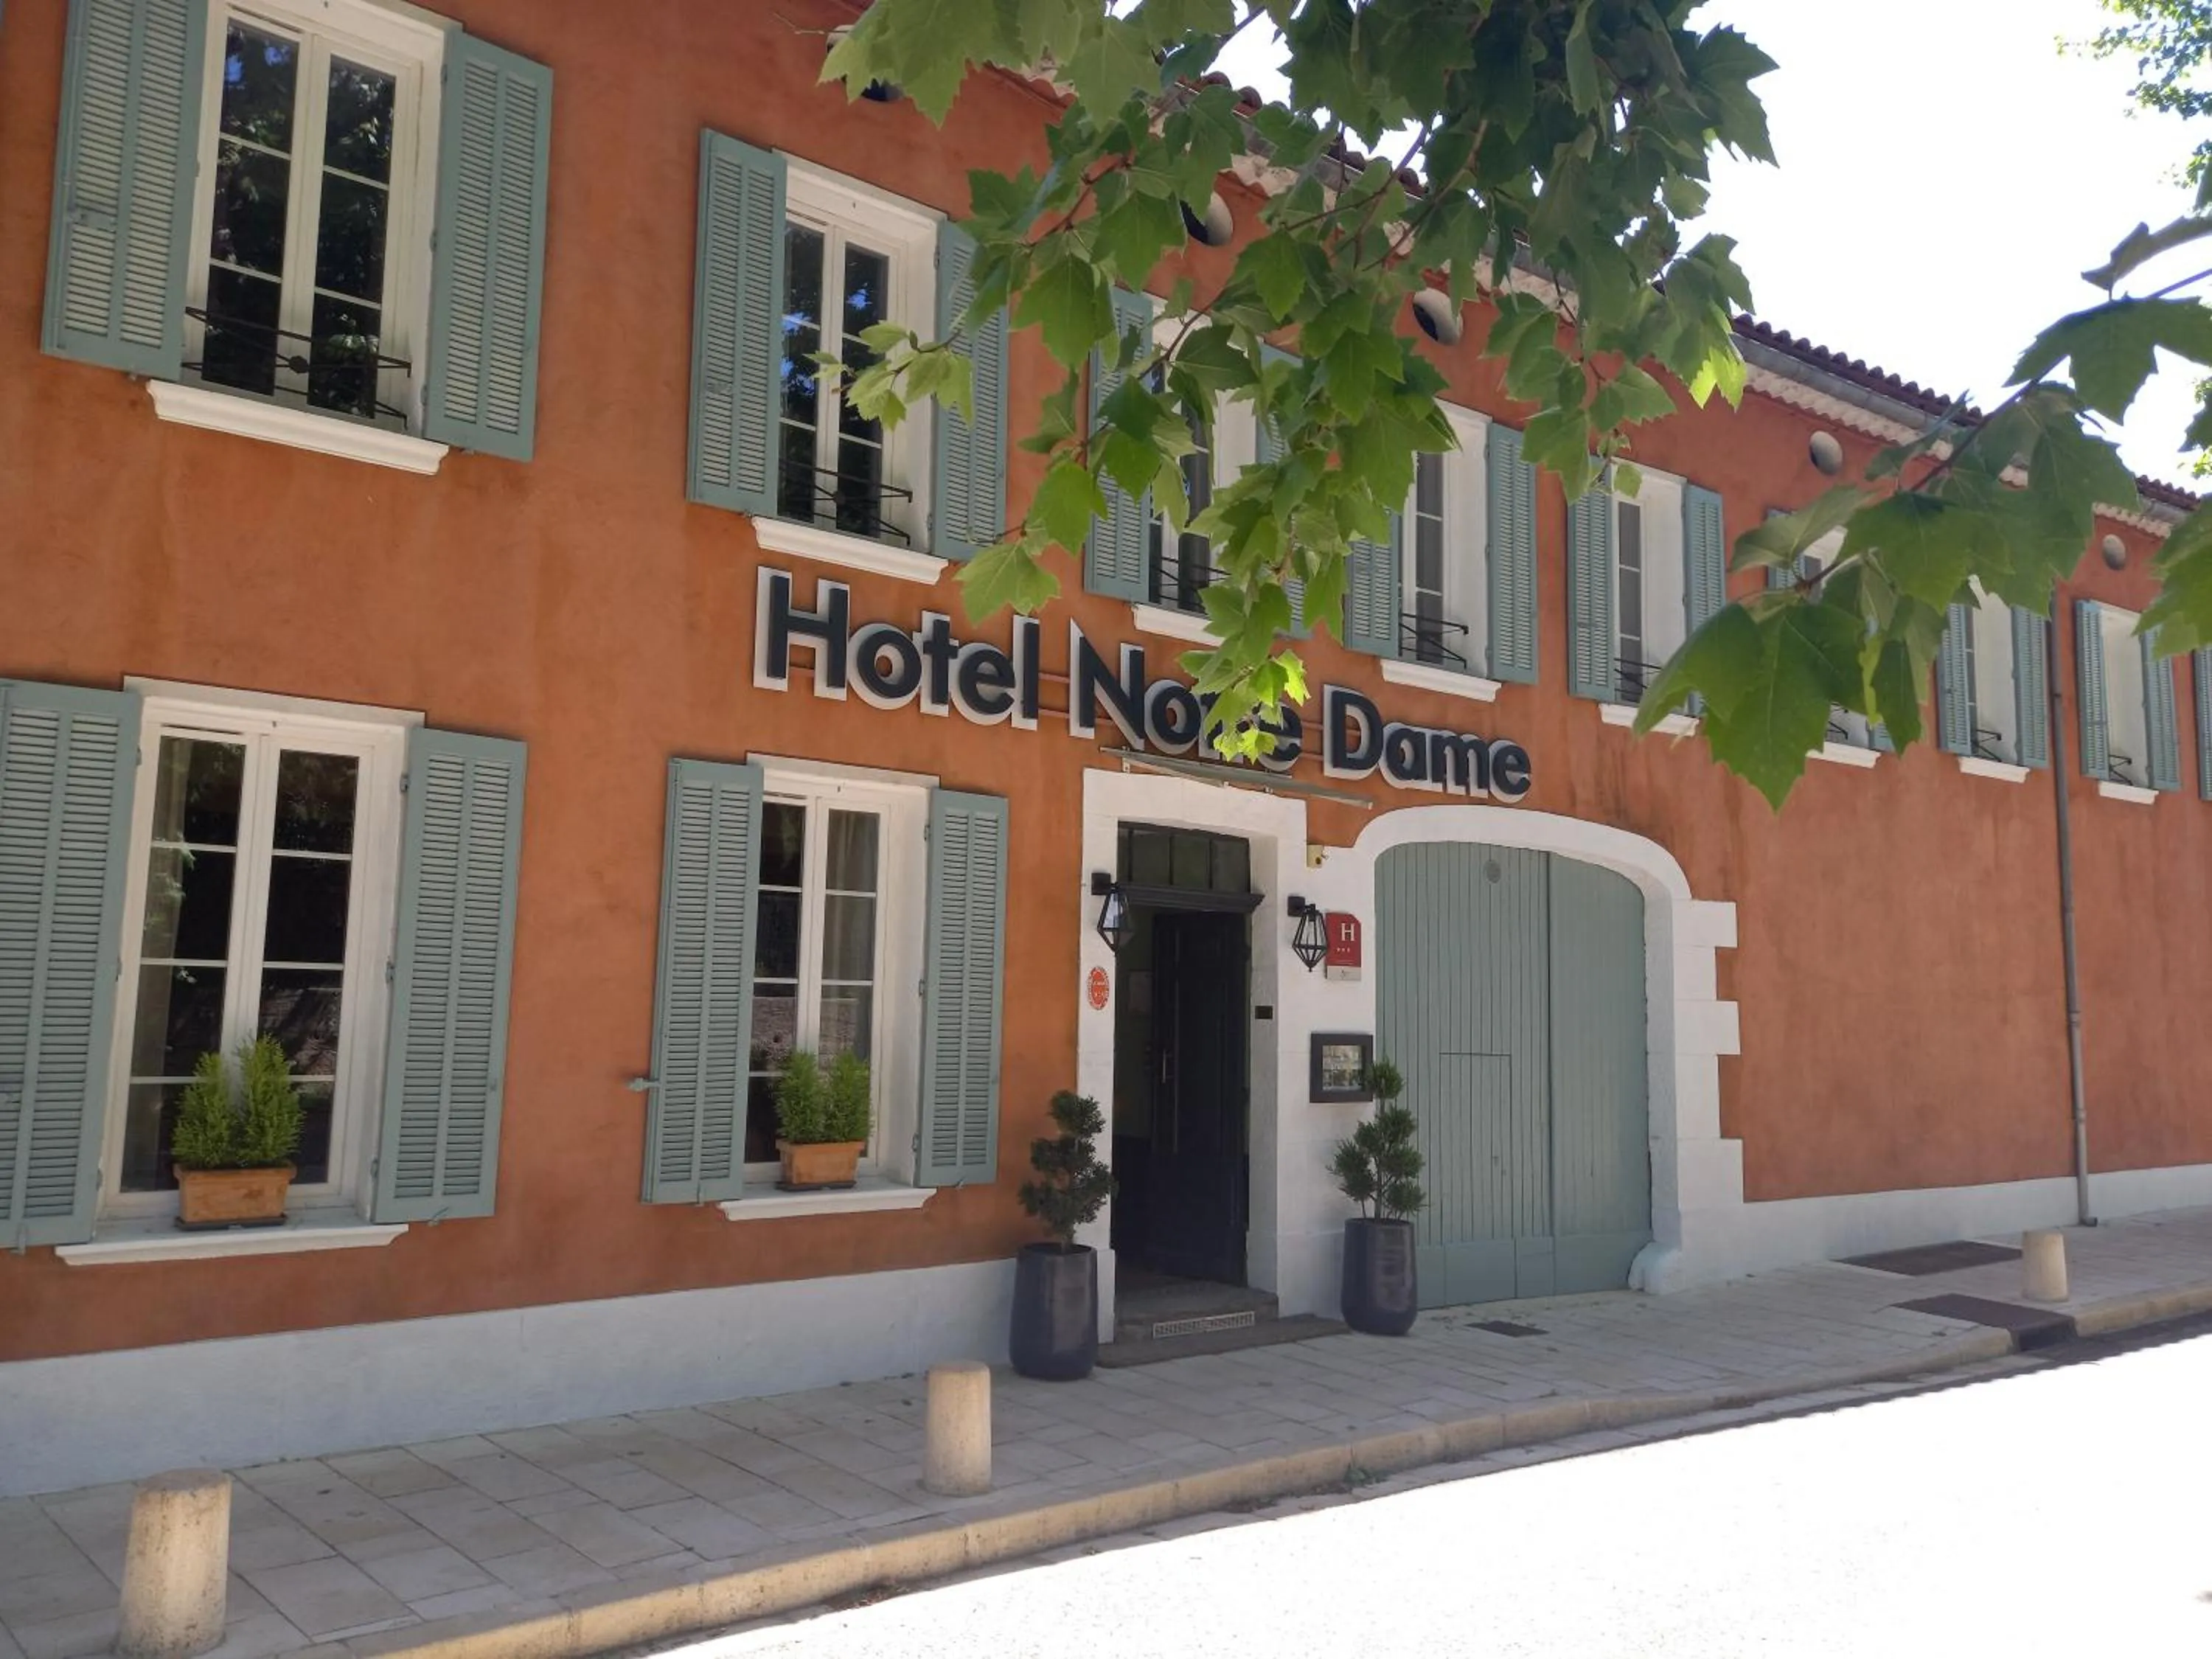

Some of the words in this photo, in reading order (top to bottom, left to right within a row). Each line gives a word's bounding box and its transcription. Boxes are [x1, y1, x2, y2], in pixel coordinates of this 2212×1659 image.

[754, 567, 1039, 730] Hotel
[1070, 618, 1302, 771] Noe
[1324, 684, 1531, 803] Dame
[1341, 922, 1354, 942] H
